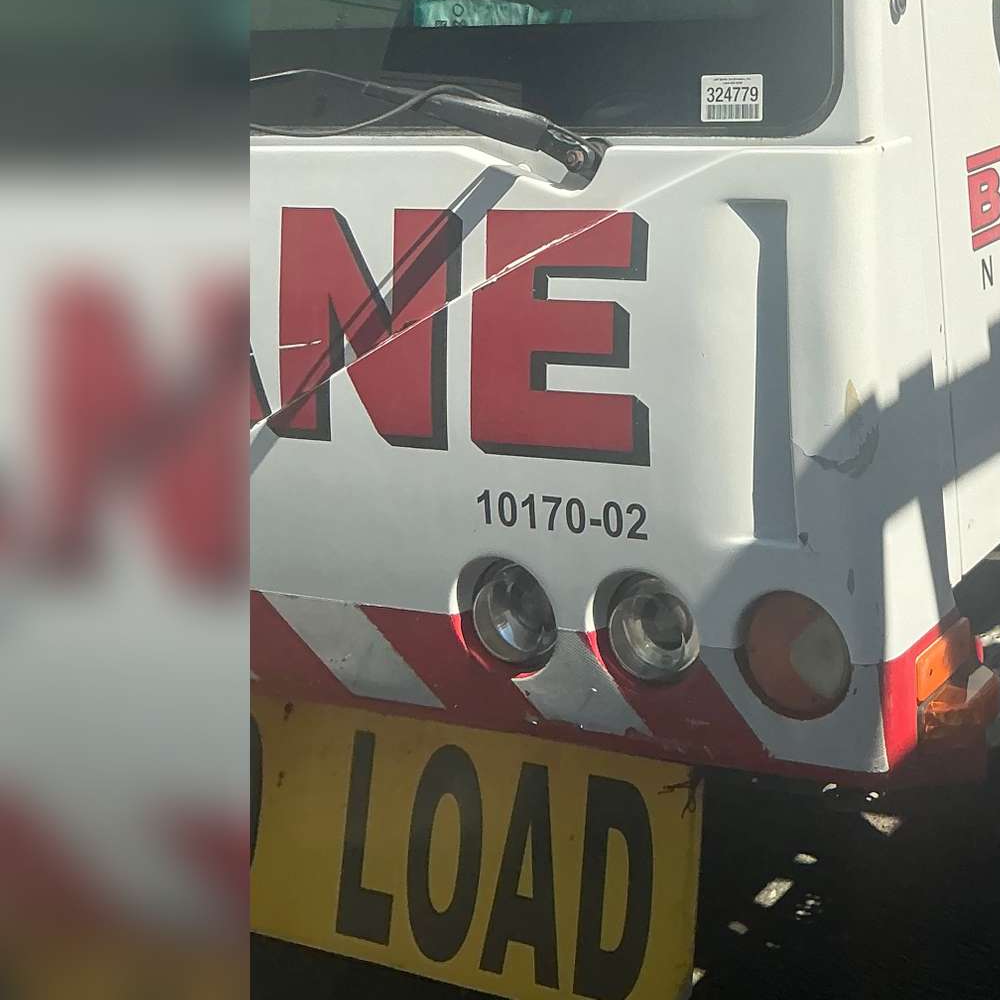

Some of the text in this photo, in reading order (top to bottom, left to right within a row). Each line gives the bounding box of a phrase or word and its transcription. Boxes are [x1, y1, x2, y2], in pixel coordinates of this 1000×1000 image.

[706, 86, 759, 103] 324779
[476, 488, 649, 541] 10170-02
[336, 730, 654, 1000] LOAD
